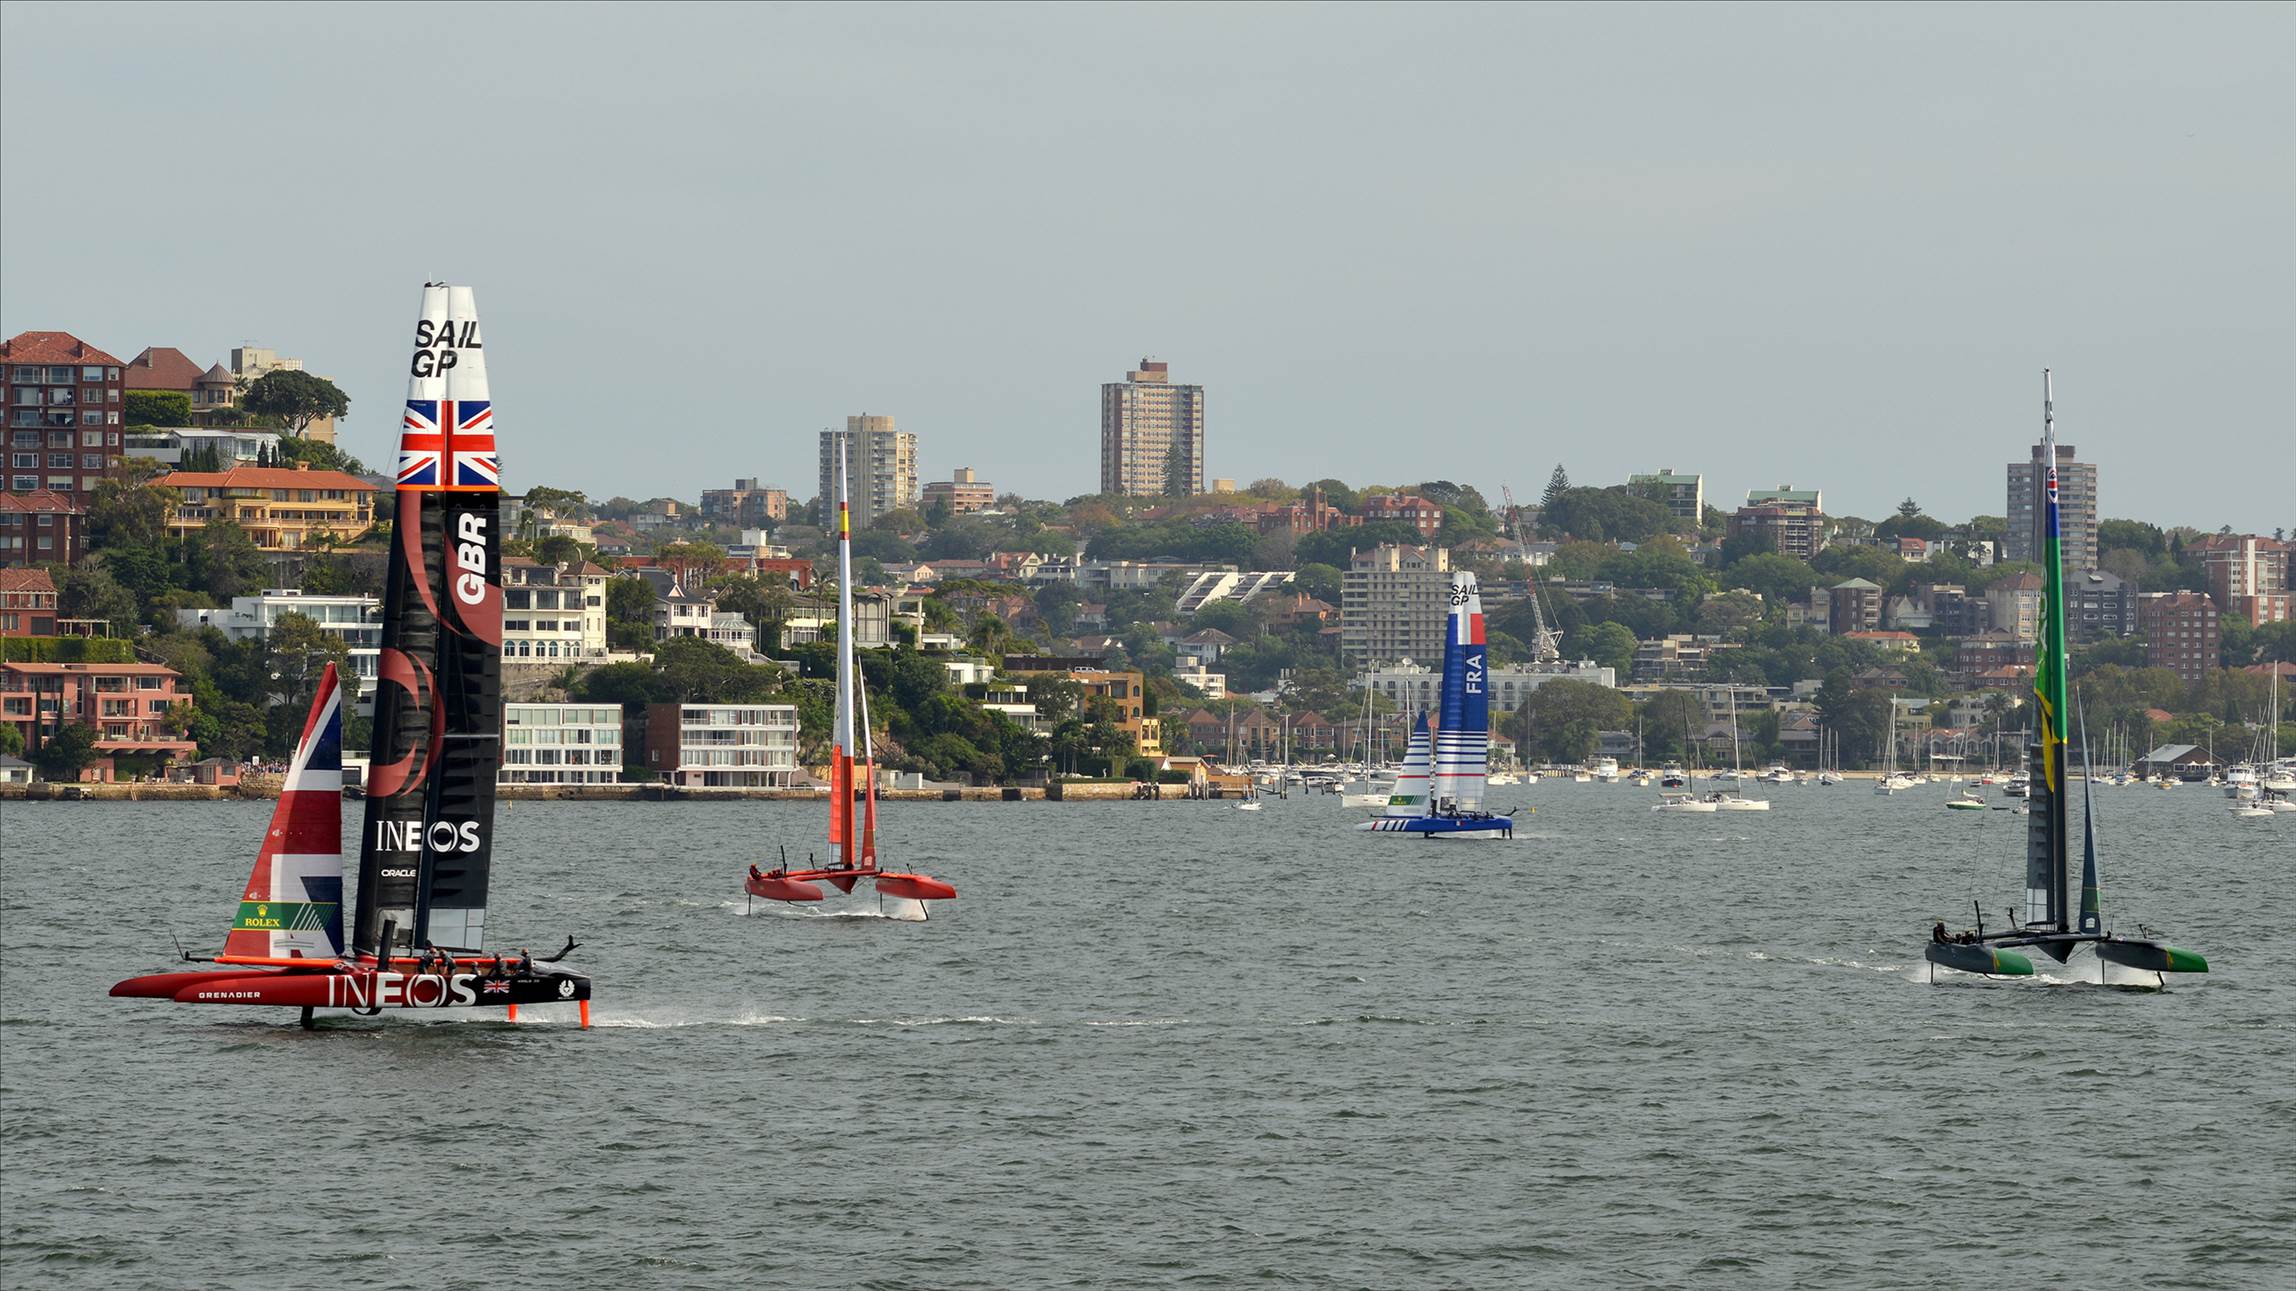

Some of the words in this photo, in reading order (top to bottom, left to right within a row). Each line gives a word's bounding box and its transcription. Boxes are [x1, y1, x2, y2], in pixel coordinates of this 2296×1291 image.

[414, 319, 482, 349] SAIL
[411, 349, 458, 378] GP
[456, 512, 487, 605] GBR
[1450, 595, 1470, 606] GP
[1451, 584, 1479, 595] SAIL
[1465, 654, 1482, 694] FRA
[375, 820, 481, 853] INEOS
[381, 869, 416, 877] ORACLE
[245, 917, 280, 927] ROLEX
[198, 991, 261, 999] GRENADIER
[326, 971, 478, 1008] INEOS
